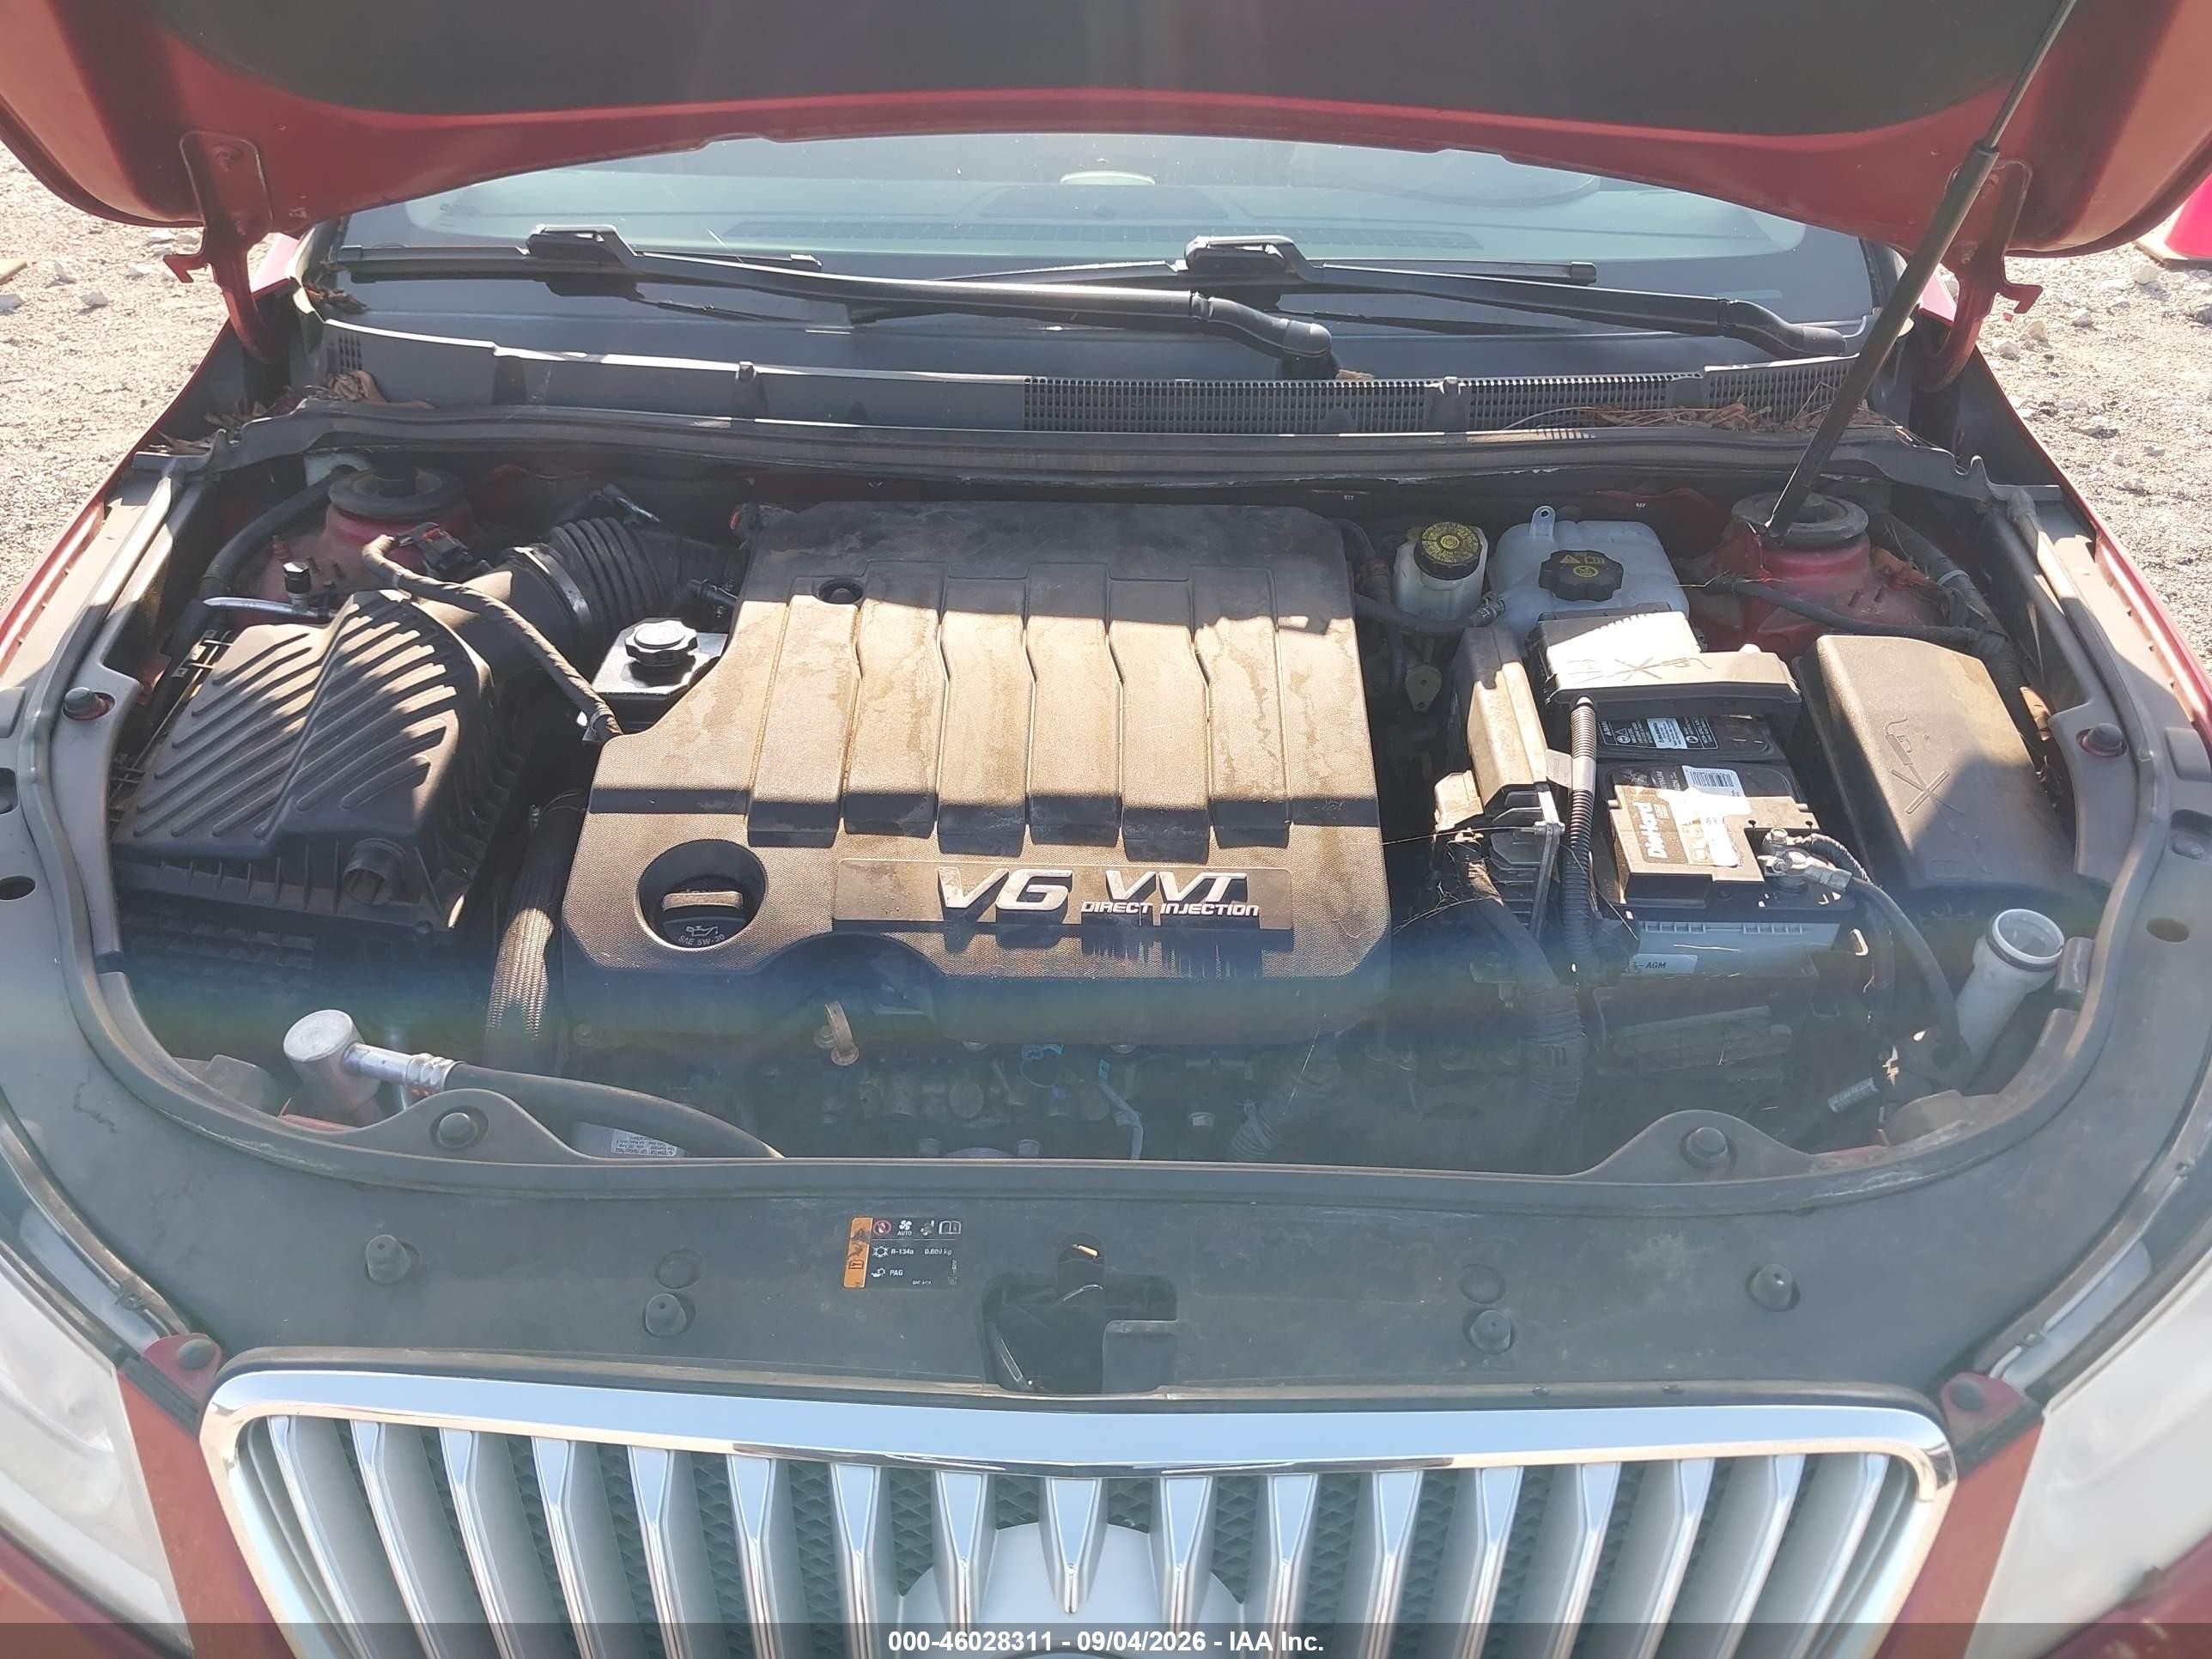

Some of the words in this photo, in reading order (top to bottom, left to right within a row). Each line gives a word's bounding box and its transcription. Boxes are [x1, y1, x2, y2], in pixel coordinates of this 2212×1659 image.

[1634, 800, 1668, 859] DieHard
[939, 867, 1073, 910] V6
[1106, 870, 1248, 902] VVT
[1081, 902, 1154, 914] DIRECT
[1160, 903, 1259, 916] INJECTION
[678, 935, 694, 945] SAE
[696, 933, 726, 945] 5W-30
